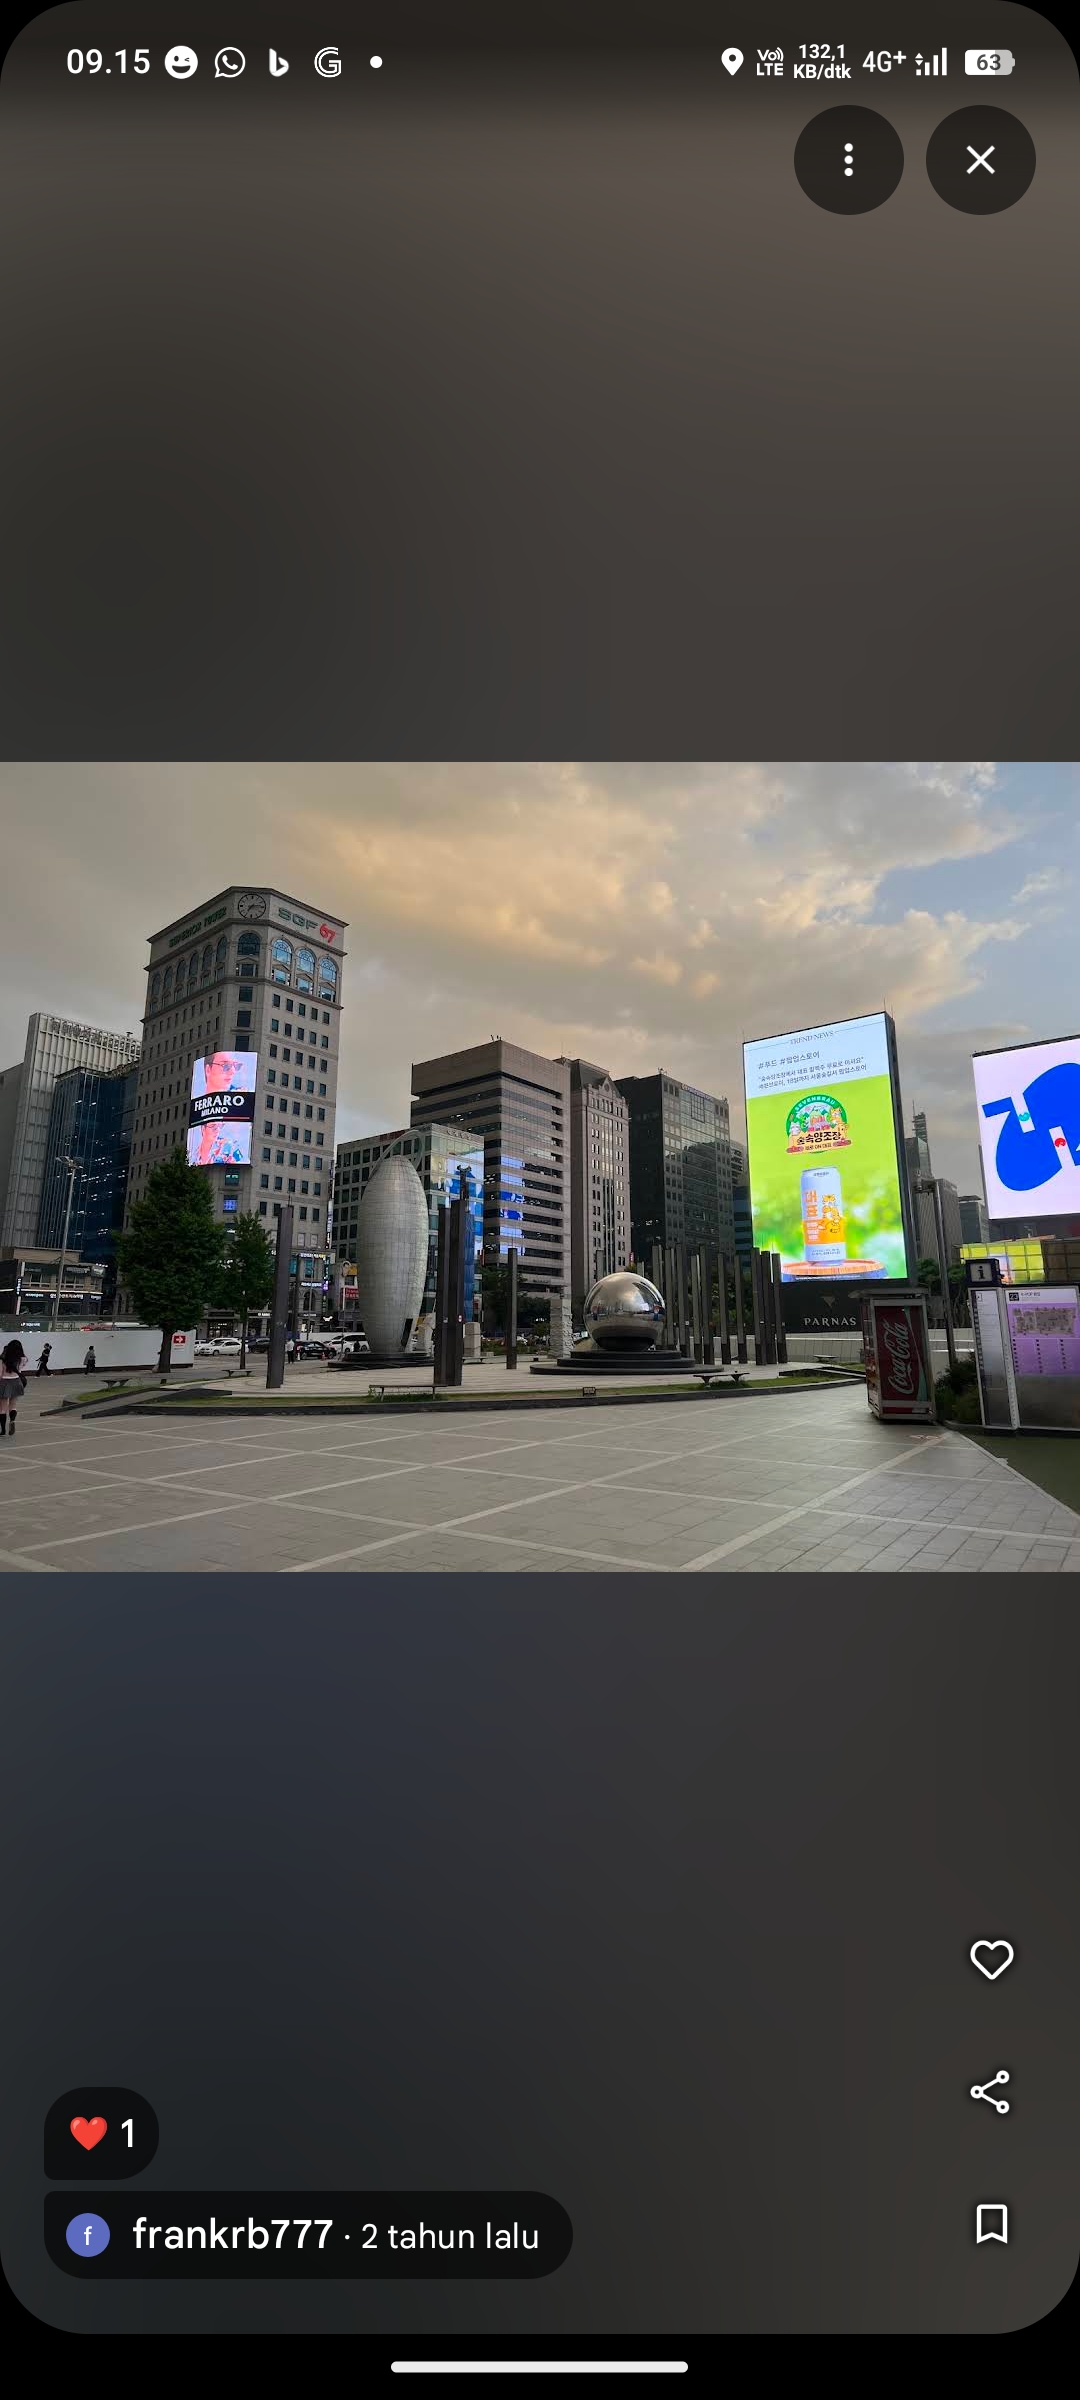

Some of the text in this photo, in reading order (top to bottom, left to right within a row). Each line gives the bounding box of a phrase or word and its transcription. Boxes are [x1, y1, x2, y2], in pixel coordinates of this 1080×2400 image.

[790, 1030, 834, 1045] TREND NEWS
[757, 1050, 820, 1069] #푸드 #팝업스토어
[838, 1064, 867, 1075] 팝업스토어
[194, 1095, 245, 1111] FERRARO
[201, 1106, 229, 1117] MILANO
[796, 1131, 842, 1146] 숲속양조장
[804, 1317, 857, 1327] PARNAS
